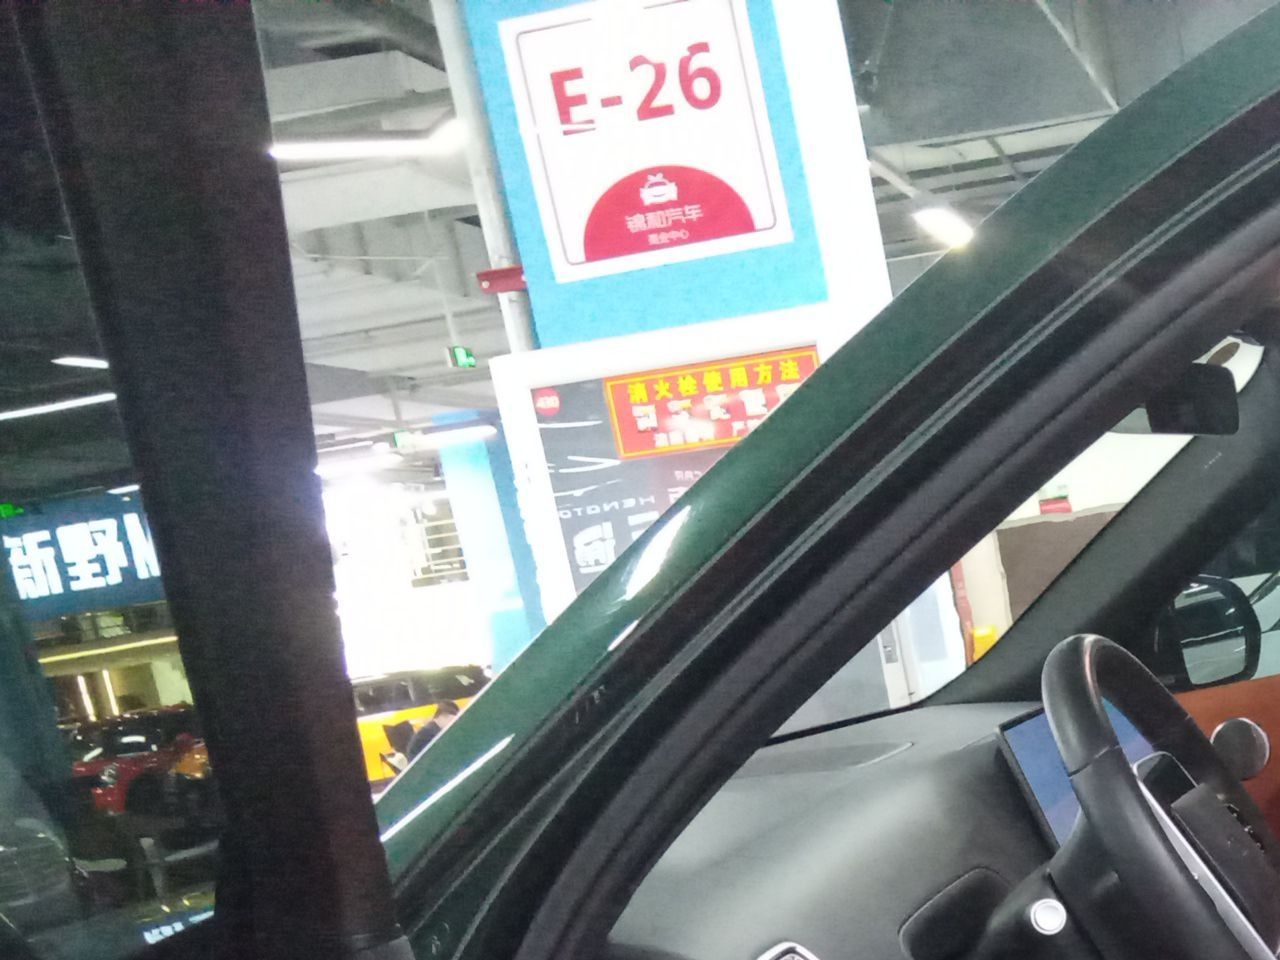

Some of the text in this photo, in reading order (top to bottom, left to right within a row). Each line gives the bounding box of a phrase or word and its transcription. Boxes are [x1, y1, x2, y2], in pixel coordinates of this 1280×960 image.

[550, 41, 722, 136] E-26
[627, 359, 800, 404] 消火栓使用方法
